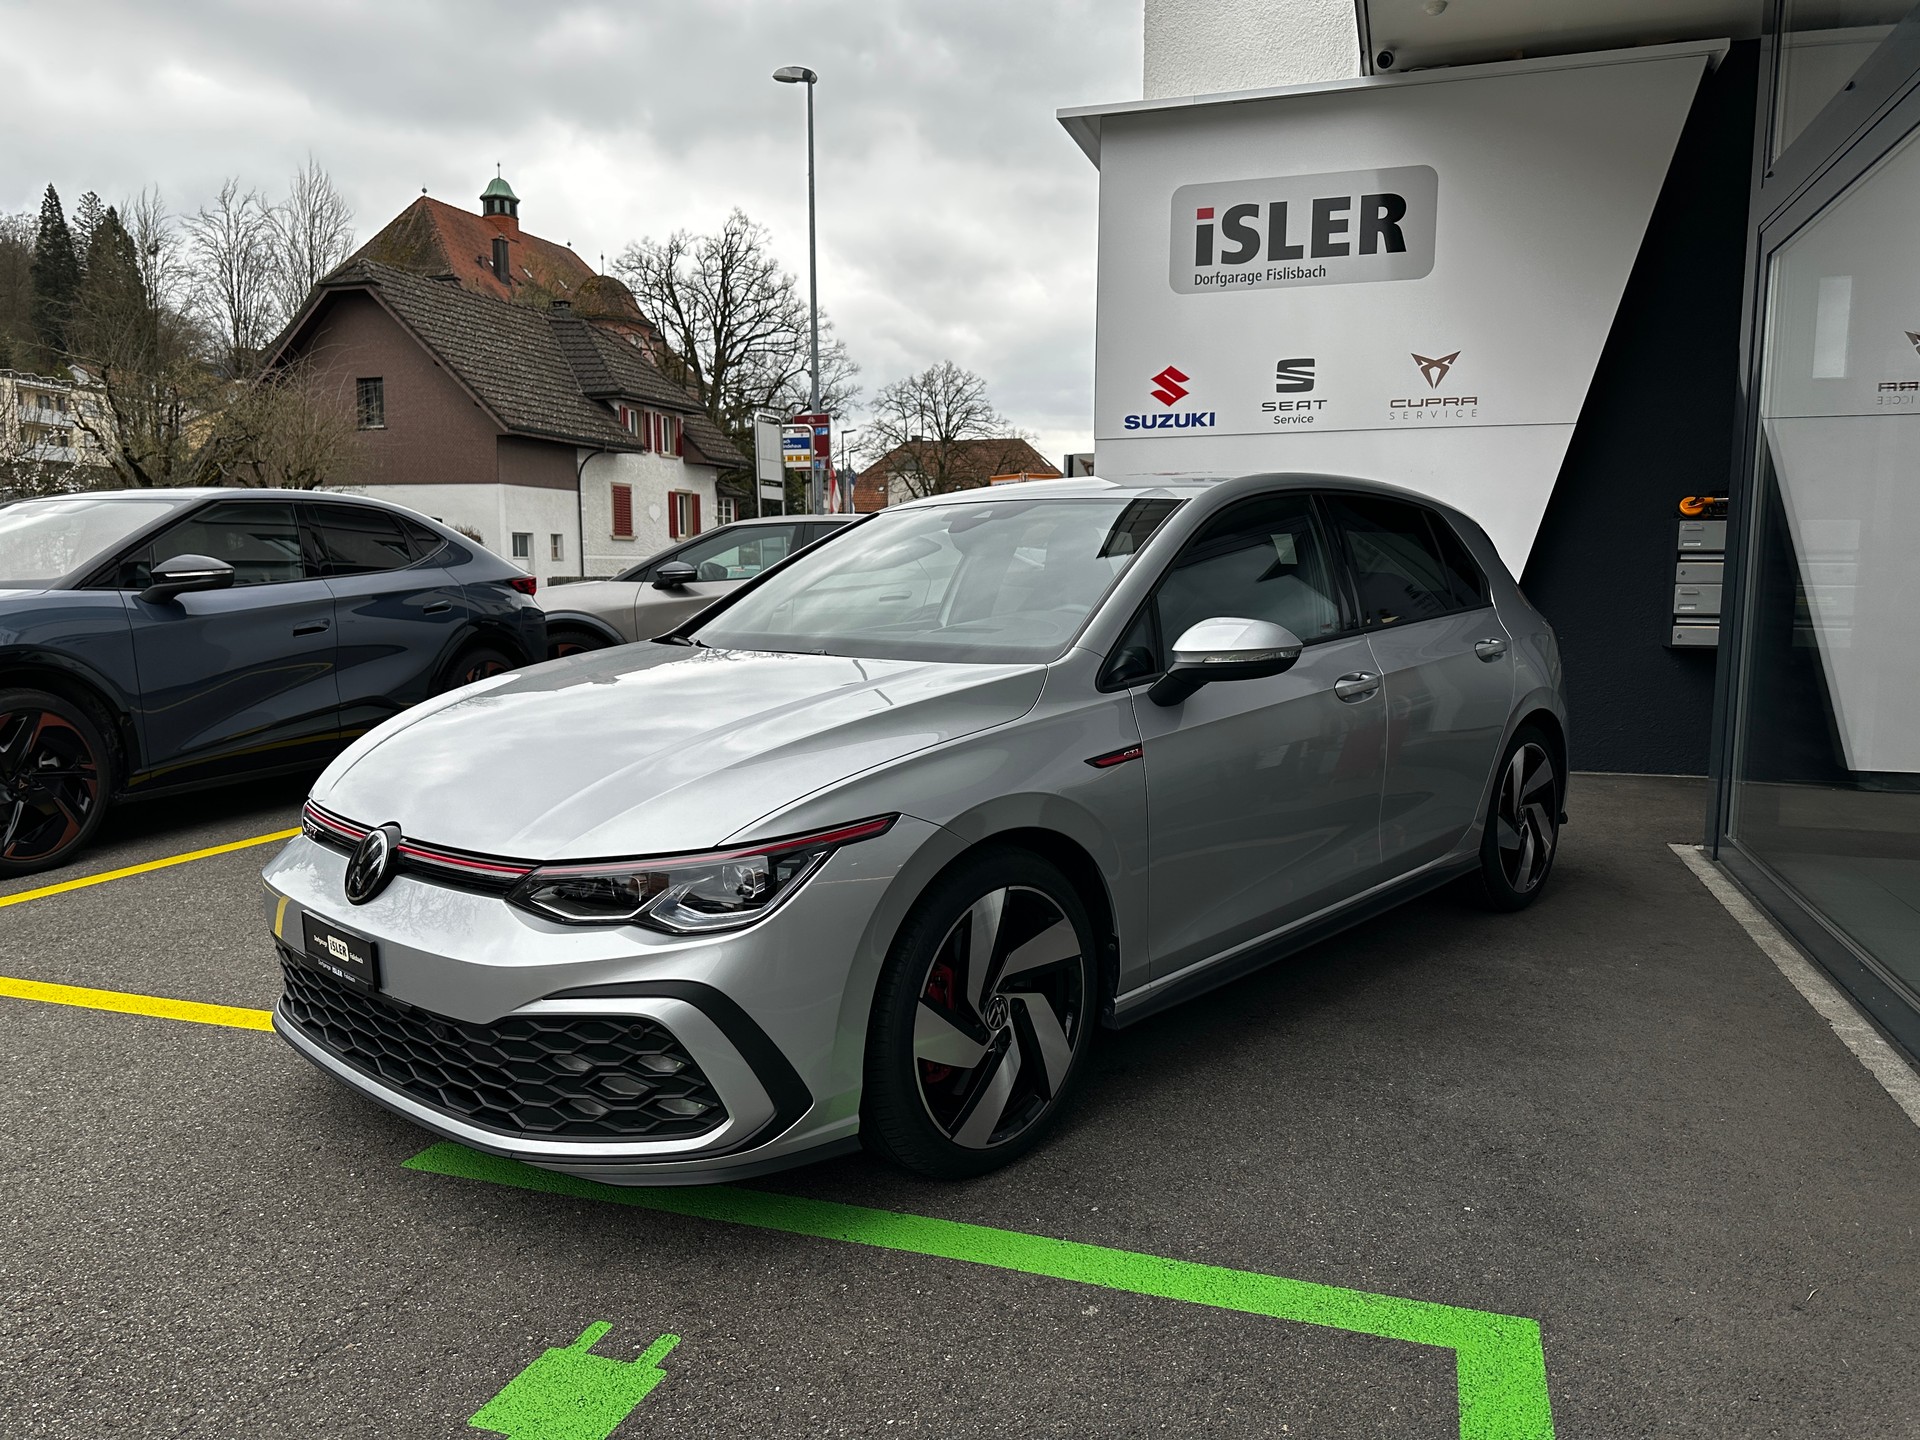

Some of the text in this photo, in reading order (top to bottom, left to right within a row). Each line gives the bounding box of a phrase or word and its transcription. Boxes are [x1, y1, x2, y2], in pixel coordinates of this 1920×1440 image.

[1195, 192, 1407, 267] iSLER
[1194, 264, 1326, 288] Dorfgarage Fislisbach
[1261, 399, 1328, 412] SEAT
[1390, 396, 1478, 408] CUPRA
[1273, 413, 1314, 425] Service
[1389, 408, 1477, 420] SERVICE
[1124, 412, 1216, 430] SUZUKI
